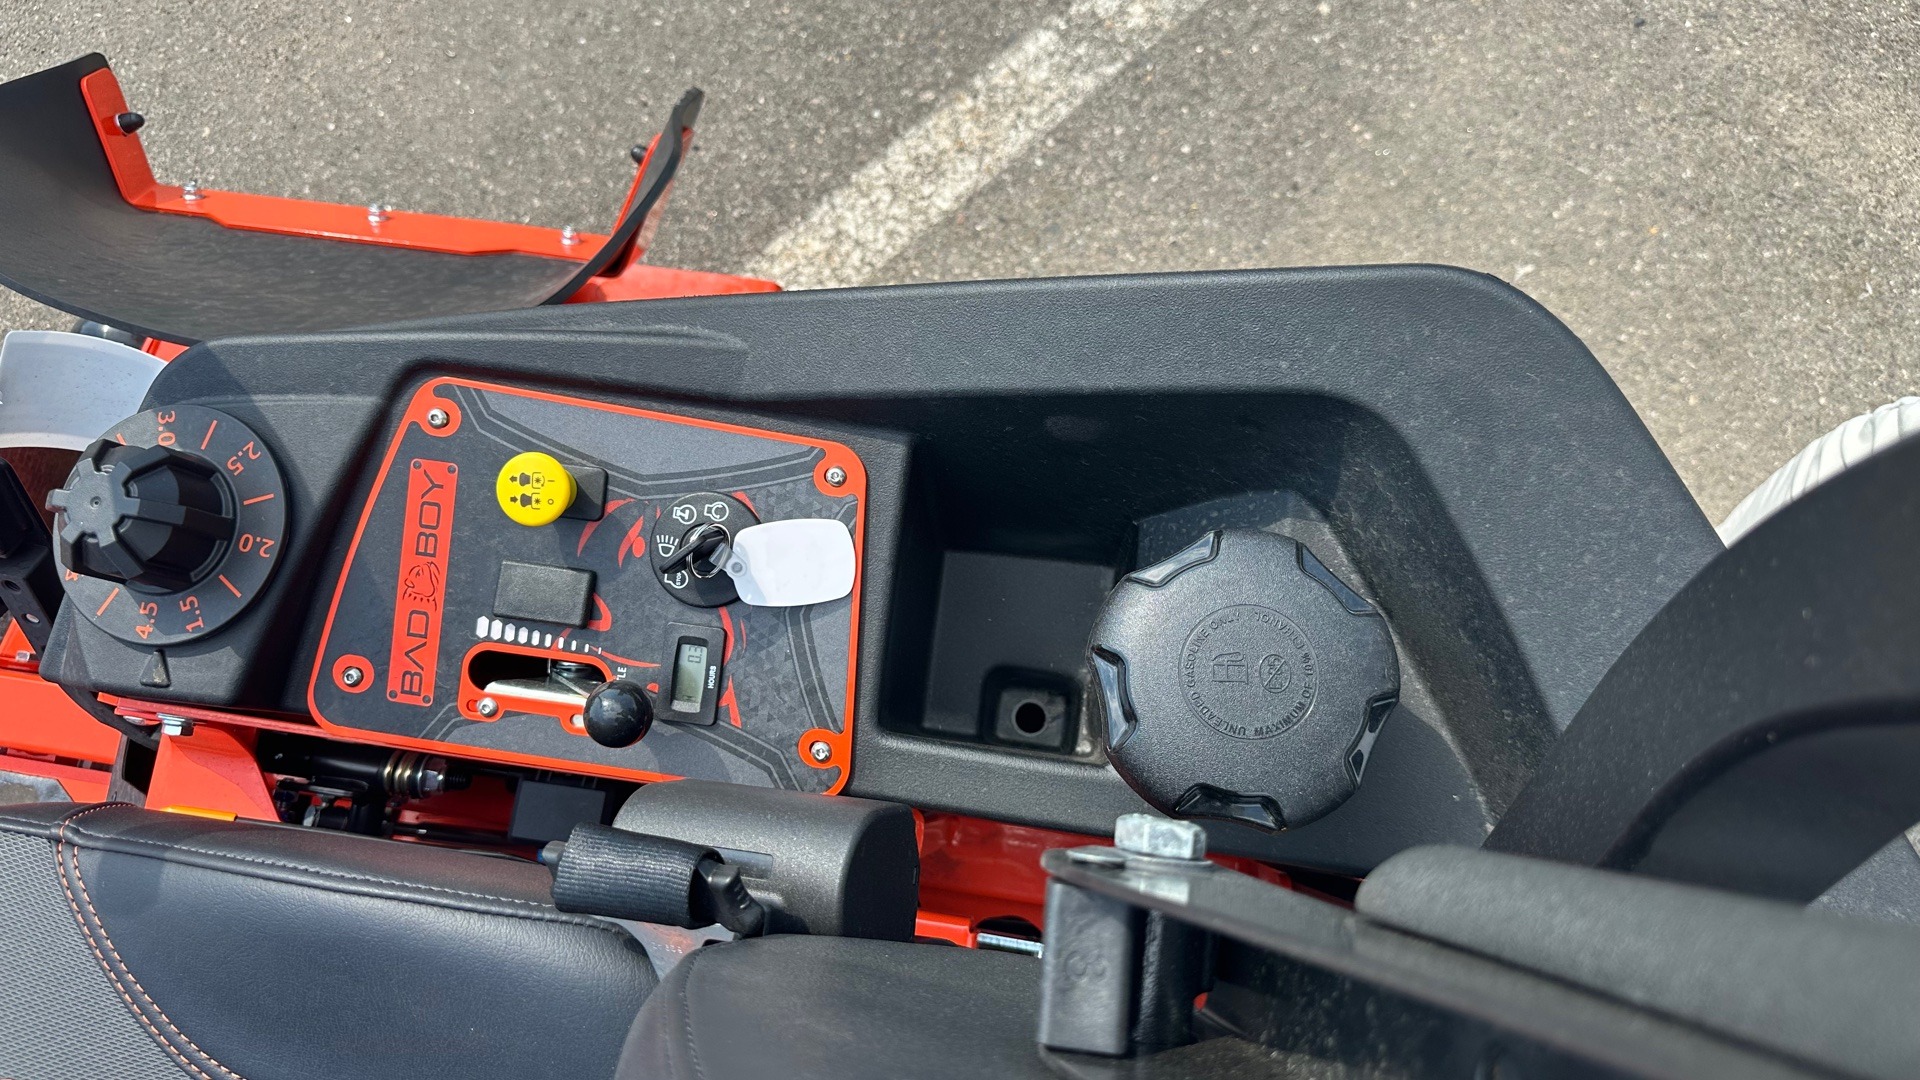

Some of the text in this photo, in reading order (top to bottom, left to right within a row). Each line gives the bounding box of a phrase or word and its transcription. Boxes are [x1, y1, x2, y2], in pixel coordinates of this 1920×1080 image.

[157, 410, 176, 446] 3.0
[226, 441, 261, 475] 2.5
[238, 533, 275, 558] 2.0
[401, 469, 444, 696] BAD BOY
[135, 601, 158, 639] 4.5
[179, 595, 204, 633] 1.5
[1184, 628, 1210, 688] GASOLINE
[1301, 652, 1314, 676] 10%
[707, 665, 717, 689] HOURS
[1302, 682, 1314, 699] OF
[1254, 702, 1306, 737] MAXIMUM
